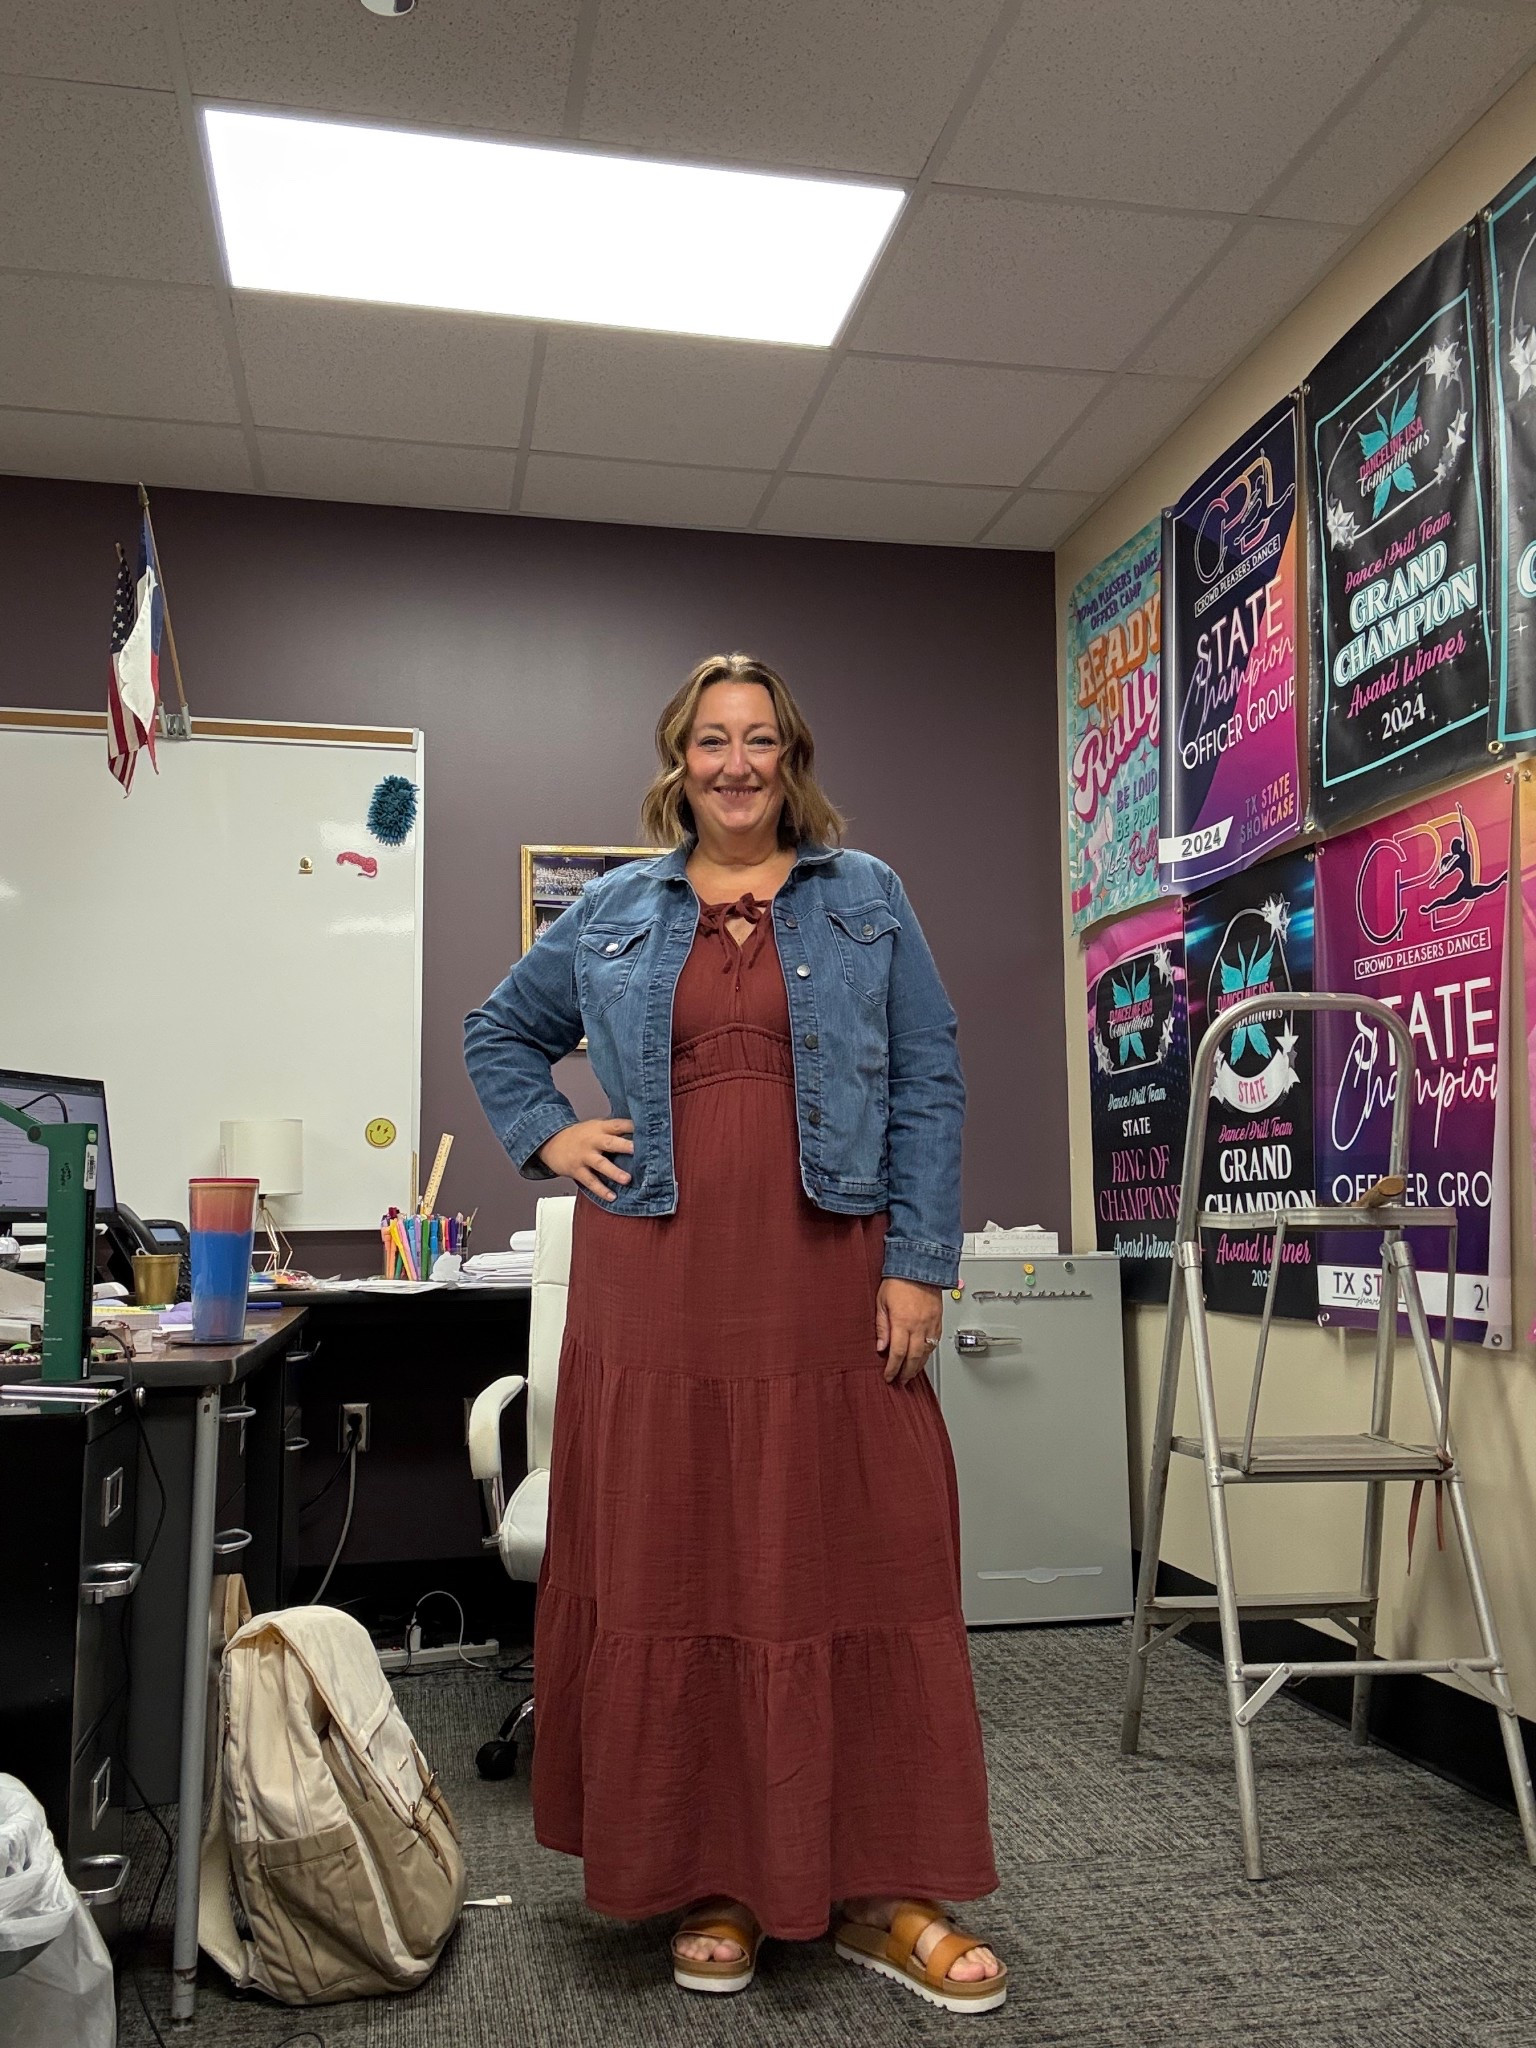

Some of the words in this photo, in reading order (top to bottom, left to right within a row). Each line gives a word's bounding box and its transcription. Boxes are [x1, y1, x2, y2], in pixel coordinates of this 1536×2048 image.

[1360, 432, 1404, 479] DANCELINE
[1405, 416, 1424, 442] USA
[1418, 511, 1452, 546] Team
[1098, 570, 1132, 607] PLEASERS
[1133, 547, 1158, 579] DANCE
[1197, 587, 1220, 613] CROWD
[1220, 562, 1251, 596] PLEASERS
[1251, 537, 1278, 570] DANCE
[1350, 541, 1448, 633] GRAND
[1090, 599, 1119, 631] OFFICER
[1120, 581, 1142, 609] CAMP
[1333, 564, 1478, 688] CHAMPION
[1078, 591, 1161, 708] READY
[1196, 575, 1283, 684] STATE
[1178, 637, 1295, 753] Champion
[1347, 660, 1399, 718] Award
[1401, 630, 1467, 687] Winner
[1097, 676, 1121, 735] TO
[1182, 713, 1243, 770] OFFICER
[1248, 676, 1295, 733] GROUP
[1381, 693, 1426, 740] 2024
[1117, 785, 1130, 813] BE
[1133, 768, 1157, 804] LOUD
[1245, 794, 1258, 818] TX
[1261, 772, 1290, 809] STATE
[1116, 813, 1130, 843] BE
[1133, 796, 1160, 833] PROU
[1240, 792, 1294, 844] SHOWCASE
[1181, 826, 1222, 859] 2024
[1357, 957, 1393, 976] CROWD
[1396, 944, 1444, 967] PLEASERS
[1447, 932, 1487, 954] DANCE
[1109, 1003, 1141, 1021] DANCELINE
[1147, 1083, 1167, 1102] Team
[1238, 1077, 1268, 1105] STATE
[1122, 1117, 1151, 1137] STATE
[1270, 1116, 1294, 1137] Team
[1112, 1148, 1146, 1183] RING
[1149, 1145, 1171, 1180] OF
[1219, 1144, 1292, 1183] GRAND
[1113, 1232, 1144, 1258] Award
[1144, 1233, 1175, 1260] Winne
[1216, 1232, 1260, 1265] Award
[1262, 1234, 1312, 1265] Wnner
[971, 1289, 1092, 1304] Frigidaire
[1333, 1271, 1355, 1295] TX
